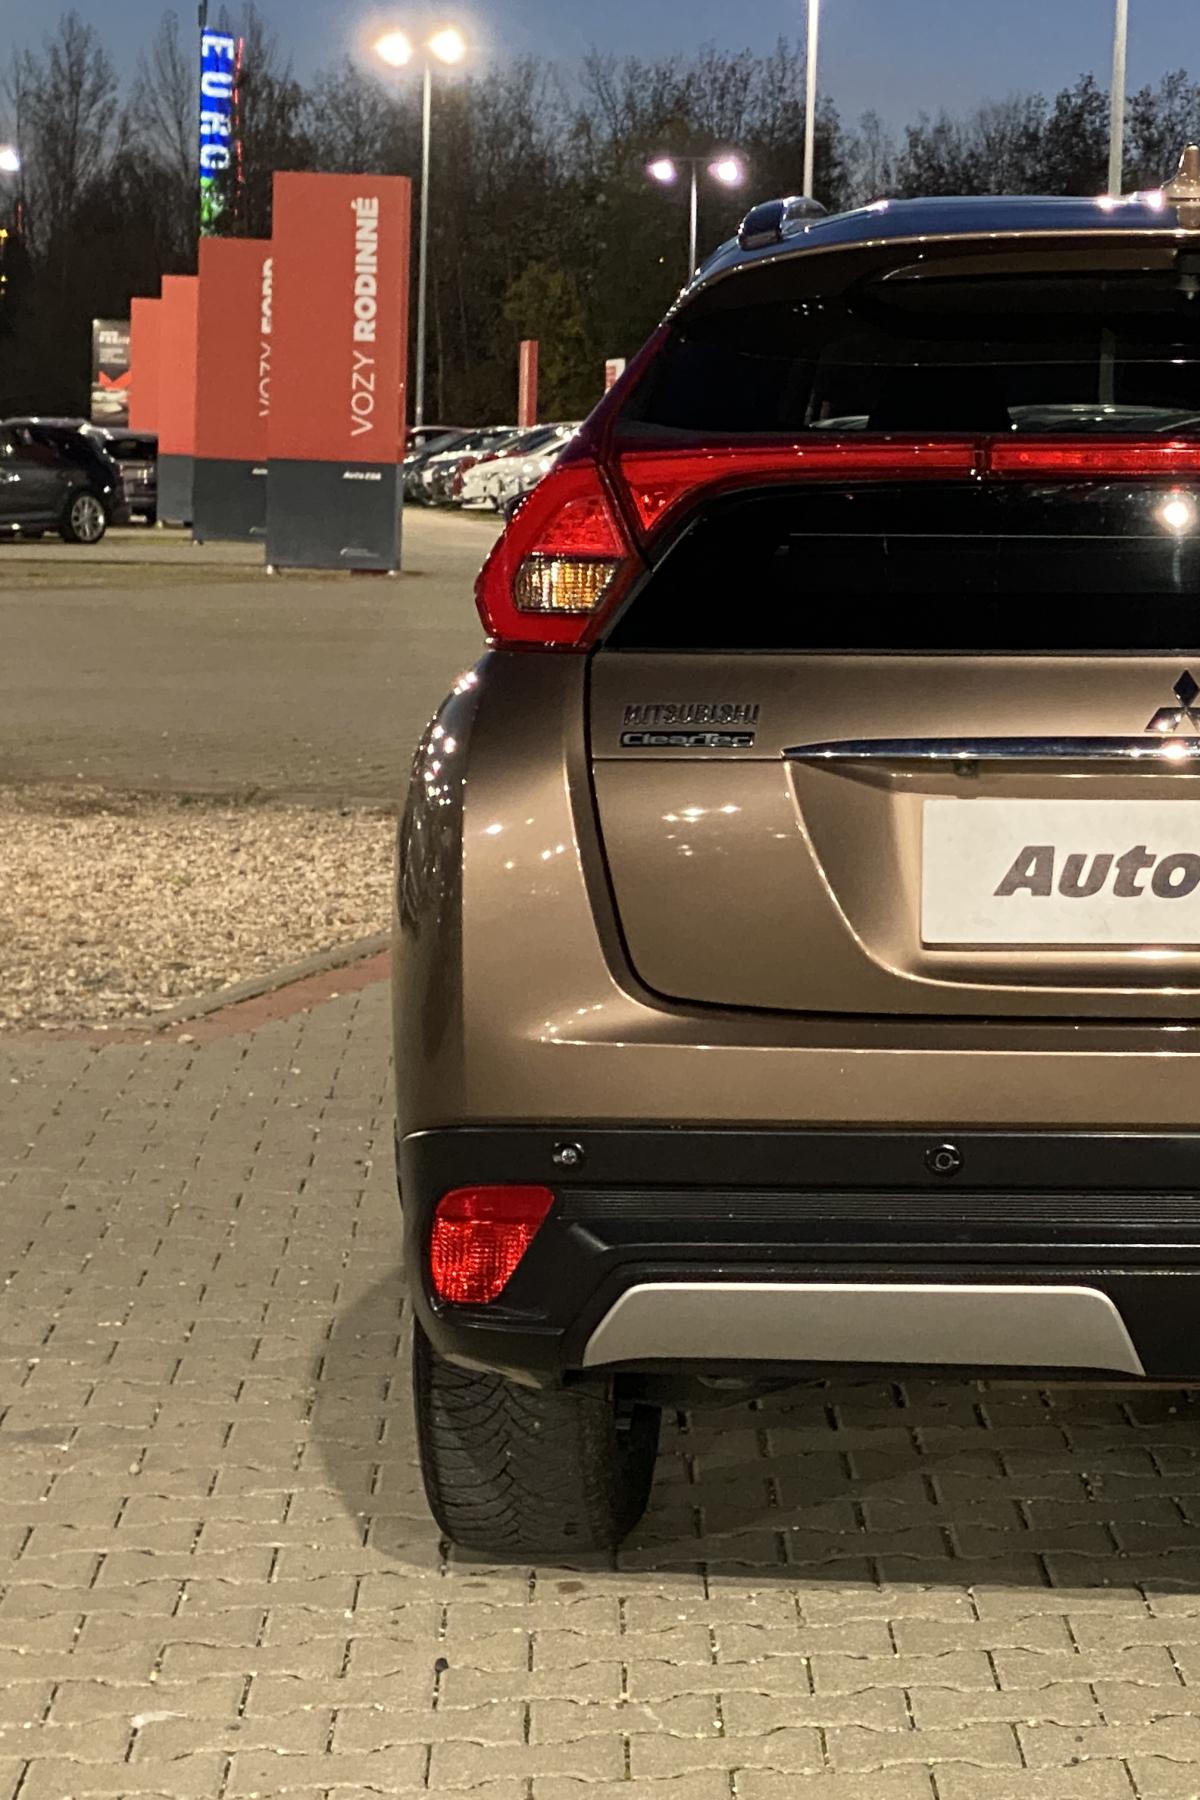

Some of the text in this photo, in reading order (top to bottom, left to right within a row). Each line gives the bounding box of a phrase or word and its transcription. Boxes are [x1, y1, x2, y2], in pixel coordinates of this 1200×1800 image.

[351, 197, 379, 436] VOZY RODINNÉ
[624, 704, 760, 725] MITSUBISHI
[623, 733, 754, 747] ClearTec
